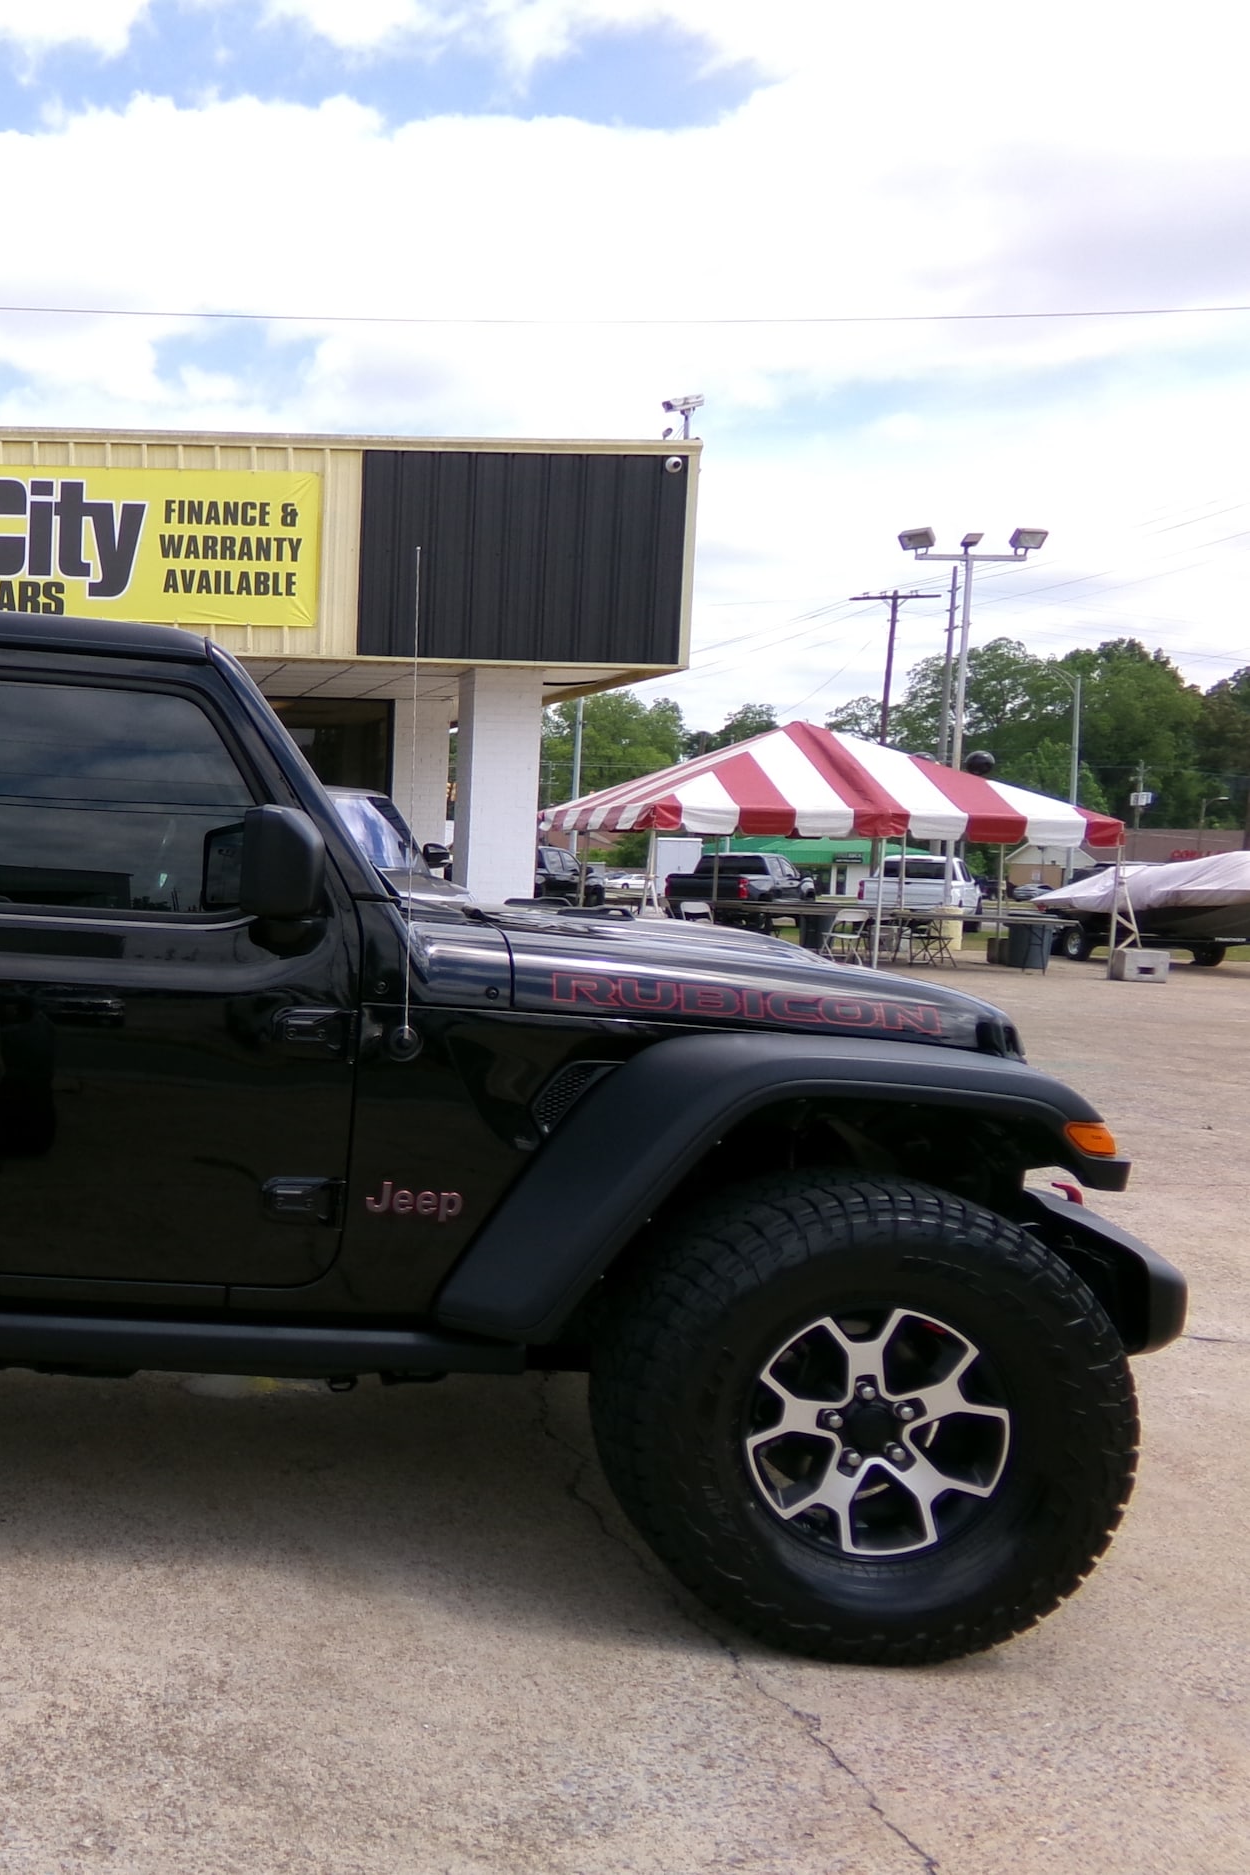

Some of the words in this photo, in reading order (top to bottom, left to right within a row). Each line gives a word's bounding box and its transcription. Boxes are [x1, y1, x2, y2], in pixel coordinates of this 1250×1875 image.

[164, 499, 271, 526] FINANCE
[280, 502, 299, 527] &
[159, 534, 302, 562] WARRANTY
[163, 569, 297, 596] AVAILABLE
[553, 972, 943, 1035] RUBICON
[365, 1181, 463, 1222] Jeep
